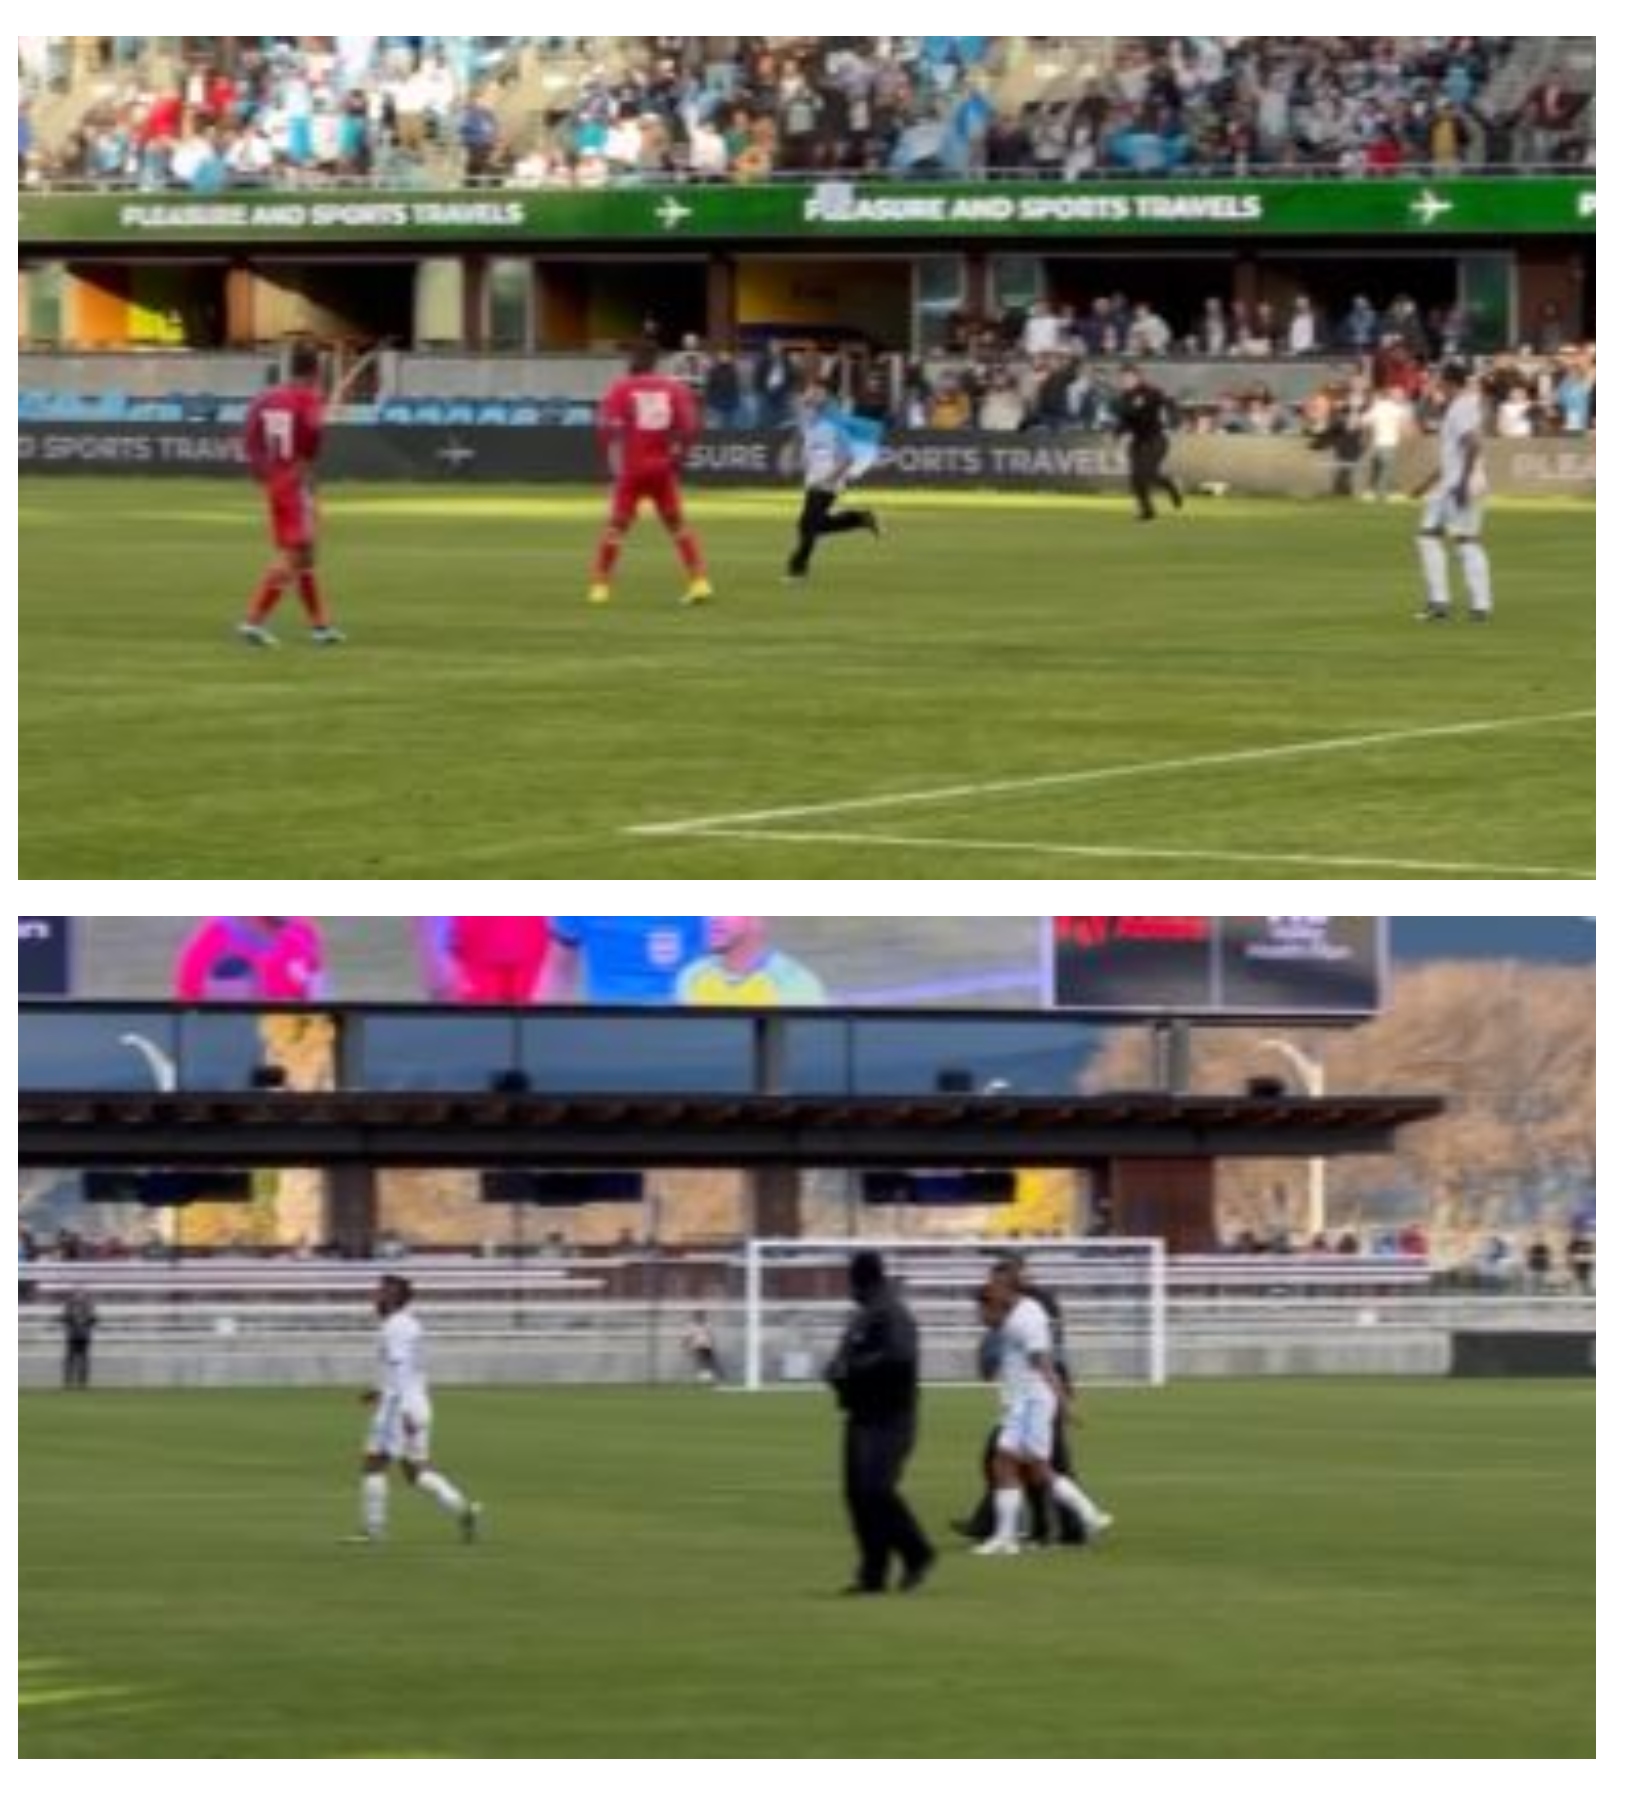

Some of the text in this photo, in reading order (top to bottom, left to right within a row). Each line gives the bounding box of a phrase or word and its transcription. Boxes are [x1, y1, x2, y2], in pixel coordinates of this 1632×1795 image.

[120, 202, 526, 226] PLEASURE AND SPORTS TRAVELS
[951, 196, 1014, 221] AND
[1018, 196, 1129, 220] SPORTS
[1135, 195, 1263, 220] TRAVELS
[42, 436, 153, 460] SPORTS
